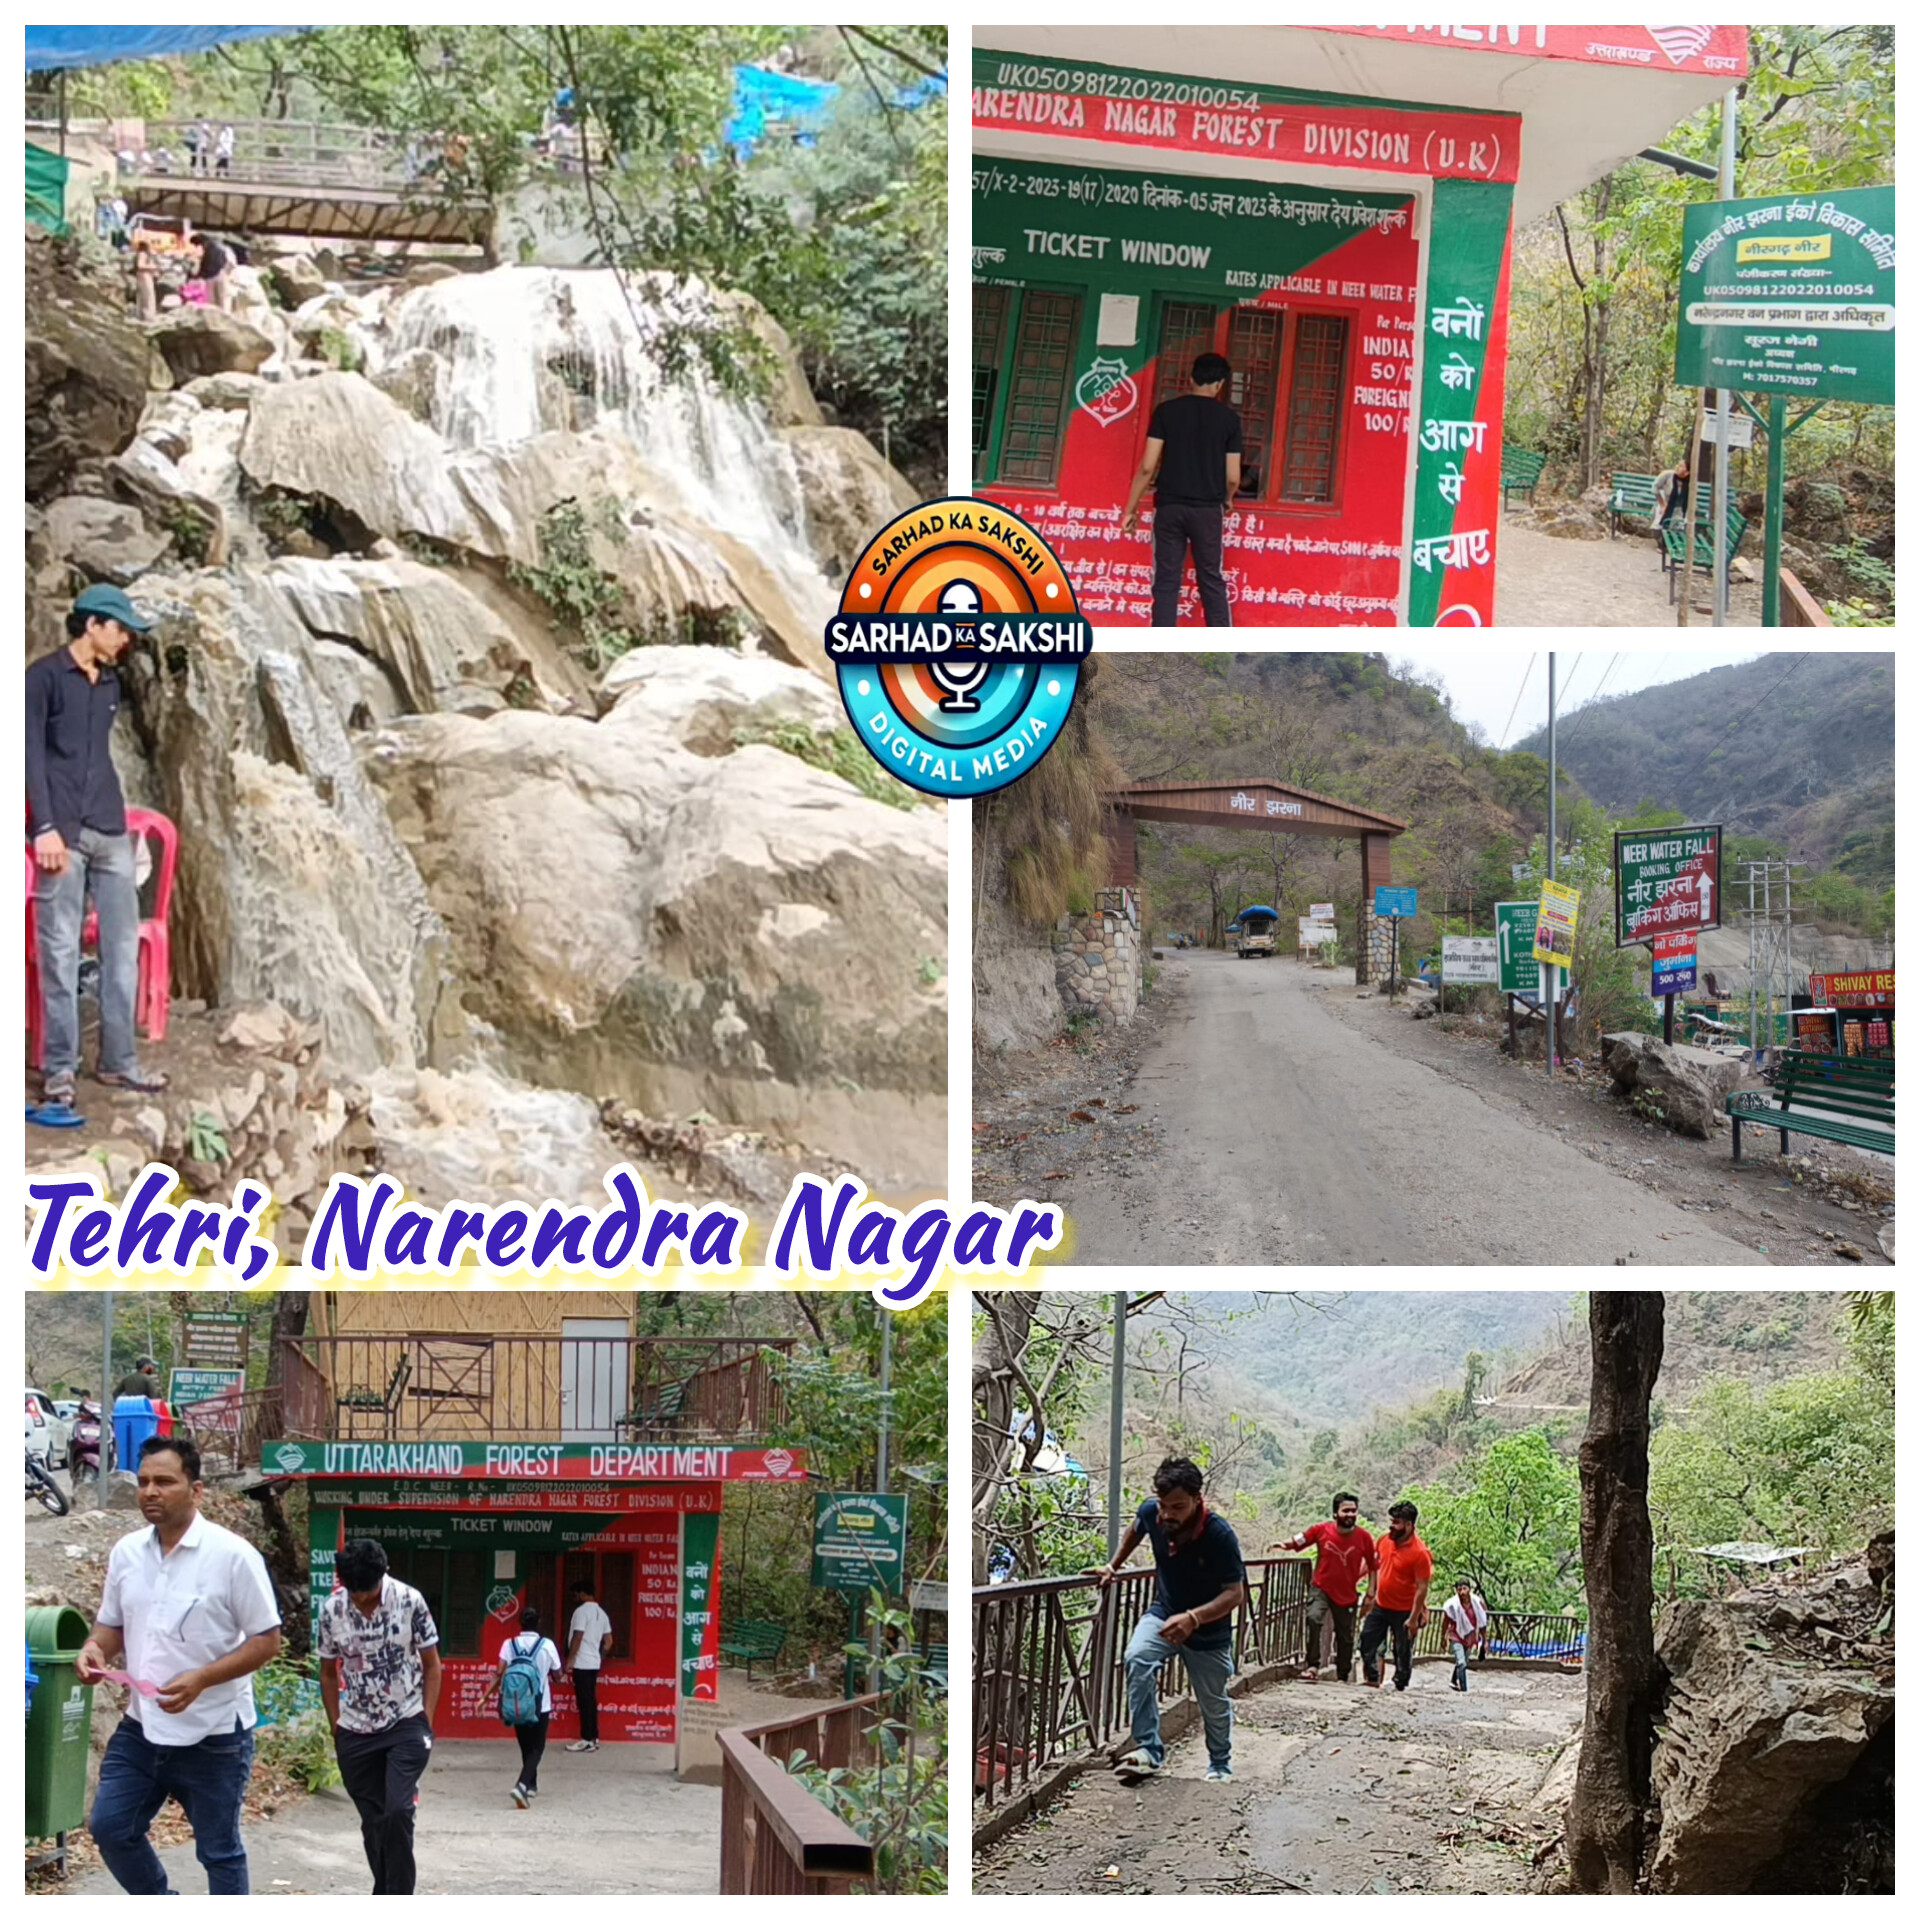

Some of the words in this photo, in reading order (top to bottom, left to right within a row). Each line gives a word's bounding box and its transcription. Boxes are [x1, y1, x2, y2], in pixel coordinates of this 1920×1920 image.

[1703, 55, 1739, 70] राज्य
[1104, 100, 1178, 138] NAGAR
[1192, 111, 1283, 151] FOREST
[1303, 123, 1410, 164] DIVISION
[1424, 129, 1500, 178] (U.K)
[1236, 195, 1266, 217] 2023
[1720, 214, 1747, 236] नीर
[1745, 205, 1783, 229] झरना
[1785, 198, 1817, 223] ईको
[1816, 201, 1867, 238] विकास
[1023, 228, 1111, 260] TICKET
[1120, 239, 1211, 268] WINDOW
[1794, 239, 1822, 253] नीर
[1225, 269, 1257, 287] RATES
[1260, 273, 1322, 294] APPLICABLE
[1327, 279, 1338, 294] IN
[1370, 283, 1403, 302] WATER
[1703, 283, 1875, 297] UK05098122022010054
[1431, 296, 1485, 340] वनों
[1747, 308, 1765, 320] वन
[1768, 308, 1802, 321] प्रभाग
[1440, 352, 1475, 390] को
[1420, 418, 1488, 453] आग
[1438, 461, 1466, 505] से
[1413, 528, 1491, 573] बचाए
[1230, 791, 1257, 812] नीर
[1265, 800, 1303, 817] झरना
[1649, 839, 1682, 861] WATER
[1685, 836, 1714, 856] FALL
[1639, 863, 1671, 879] BOOKING
[1675, 858, 1704, 874] OFFICE
[1627, 878, 1653, 904] नीर
[1655, 875, 1694, 904] झरना
[1659, 974, 1674, 985] 500
[1833, 975, 1872, 992] SHIVAY
[324, 1443, 464, 1475] UTTARAKHAND
[485, 1445, 565, 1477] FOREST
[589, 1447, 733, 1477] DEPARTMENT
[359, 1492, 390, 1504] UNDER
[398, 1492, 460, 1506] SUPERVISION
[469, 1493, 482, 1506] OF
[489, 1492, 542, 1507] NARENDRA
[549, 1493, 578, 1507] NAGAR
[583, 1493, 620, 1508] FOREST
[628, 1494, 674, 1509] DIVISION
[450, 1517, 498, 1532] TICKET
[503, 1519, 553, 1533] WINDOW
[310, 1548, 337, 1565] SAVE
[690, 1584, 705, 1600] को
[683, 1611, 711, 1626] आग
[691, 1628, 703, 1646] से
